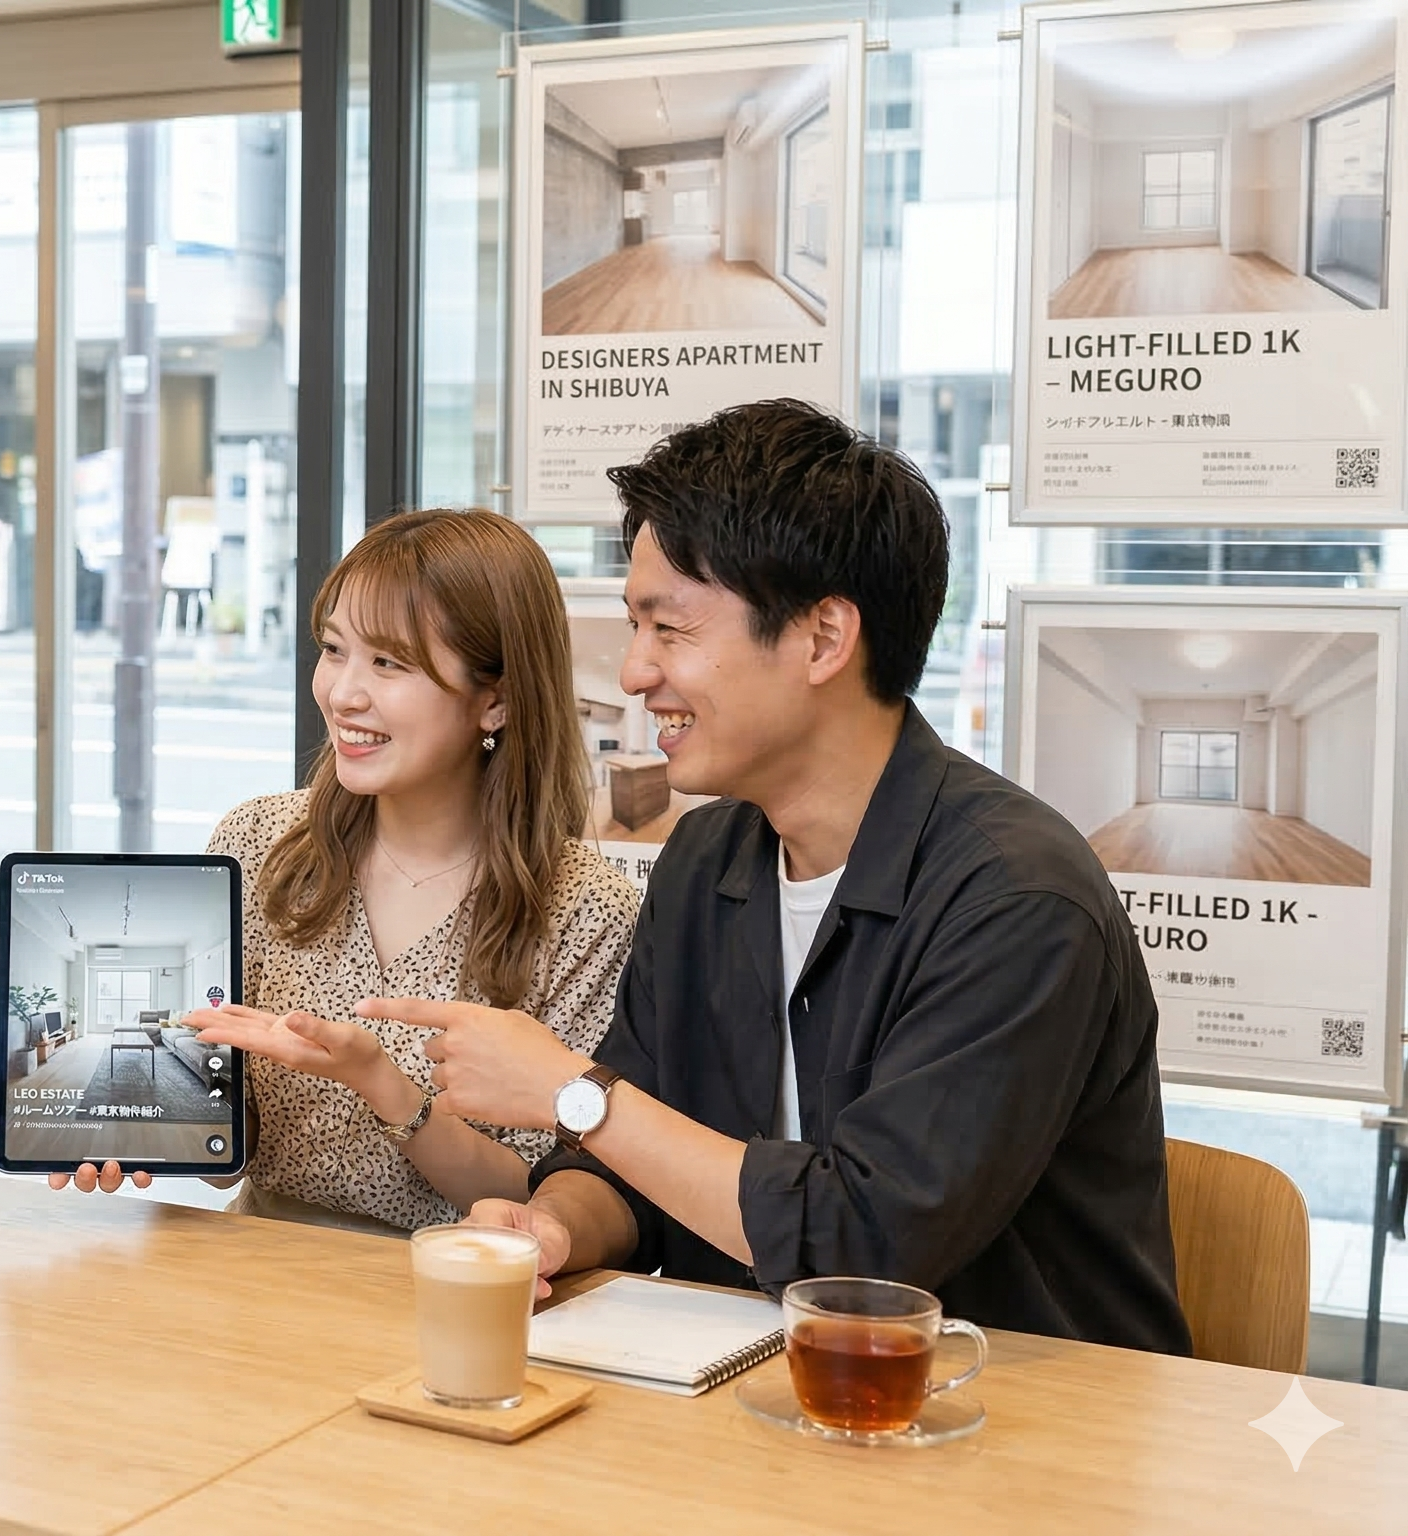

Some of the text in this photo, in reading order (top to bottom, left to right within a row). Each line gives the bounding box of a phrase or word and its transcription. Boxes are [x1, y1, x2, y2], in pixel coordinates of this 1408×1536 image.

[542, 342, 824, 370] DESIGNERS APARTMENT
[1048, 329, 1301, 359] LIGHT-FILLED 1K
[541, 377, 670, 399] IN SHIBUYA
[1071, 367, 1202, 393] MEGURO
[1120, 891, 1250, 921] T-FILLED
[1261, 898, 1299, 924] 1K
[13, 1088, 85, 1100] LEO ESTATE
